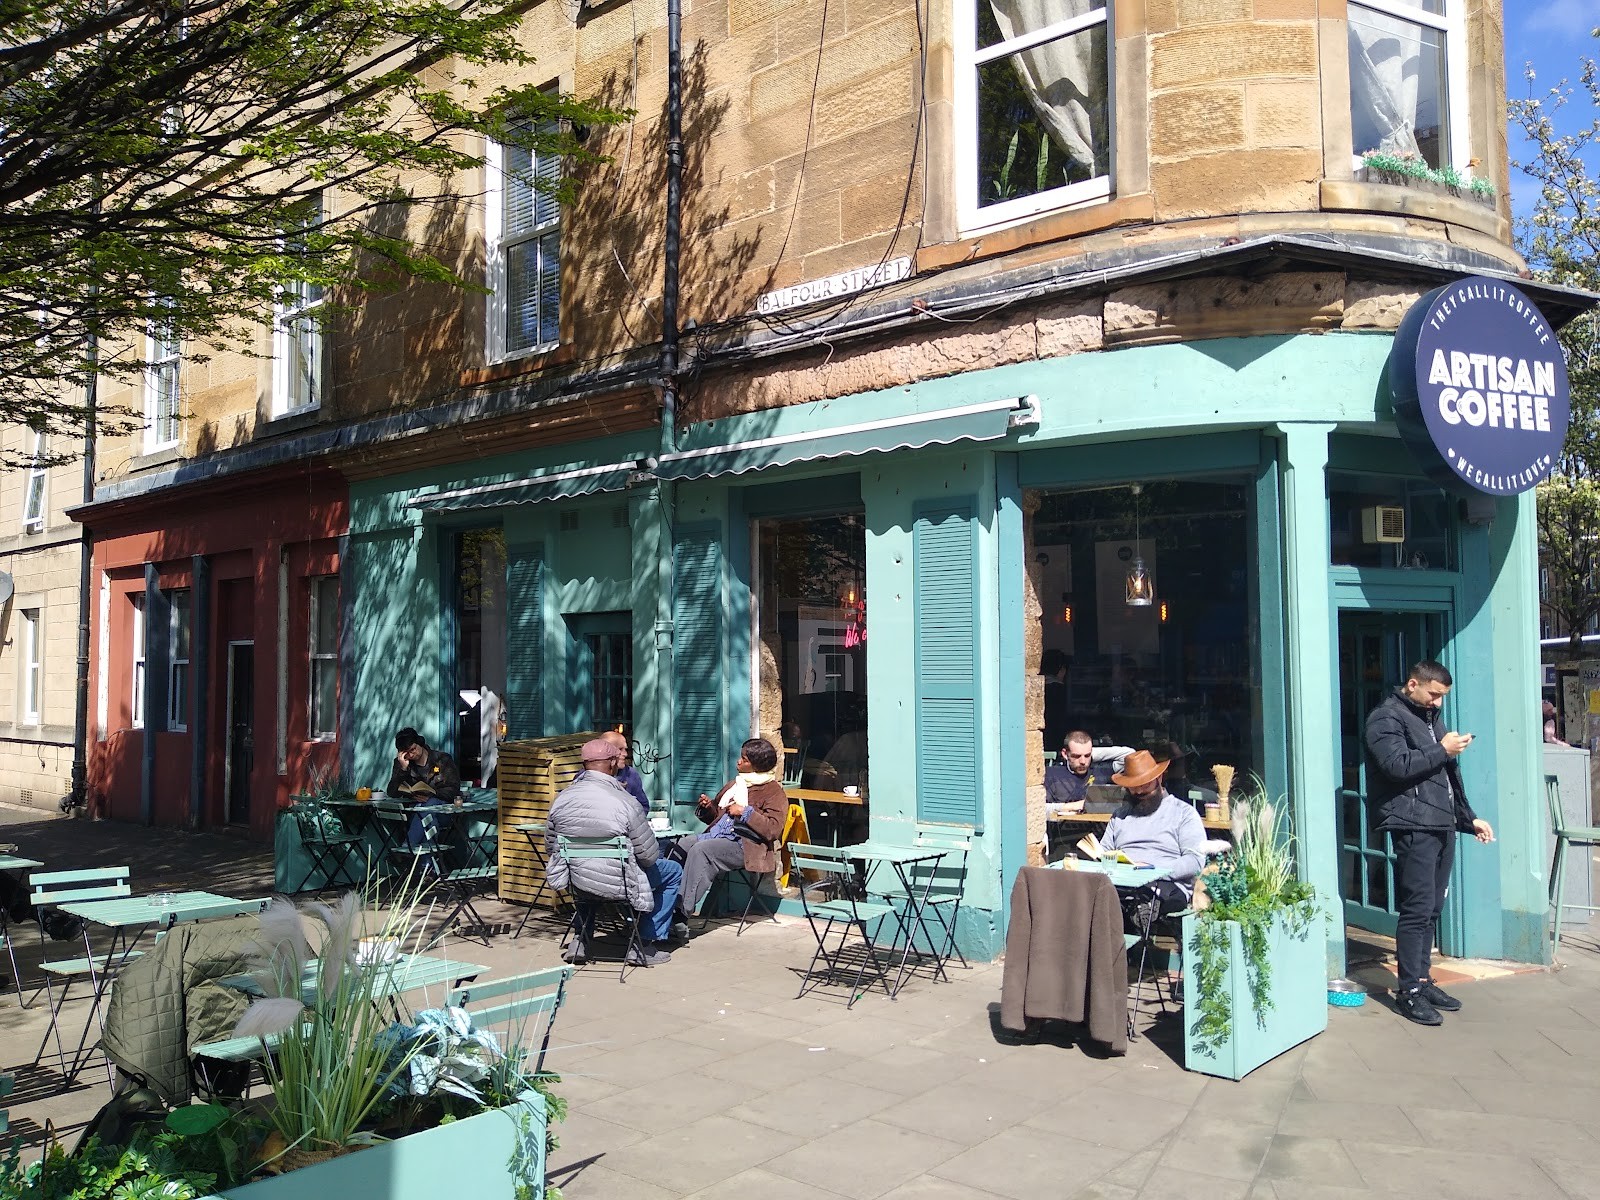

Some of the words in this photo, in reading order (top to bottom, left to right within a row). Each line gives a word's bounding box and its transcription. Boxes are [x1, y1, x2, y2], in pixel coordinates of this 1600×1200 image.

[761, 280, 833, 312] BALFOUR
[841, 260, 906, 293] STREET
[1430, 296, 1457, 330] THEY
[1459, 284, 1489, 303] CALL
[1493, 286, 1506, 302] IT
[1508, 294, 1550, 345] COFFEE
[1428, 349, 1556, 397] ARTISAN
[1438, 387, 1551, 432] COFFEE
[1457, 456, 1473, 479] WE
[1475, 471, 1504, 490] CALL
[1506, 476, 1518, 490] IT
[1519, 458, 1545, 485] LOVE
